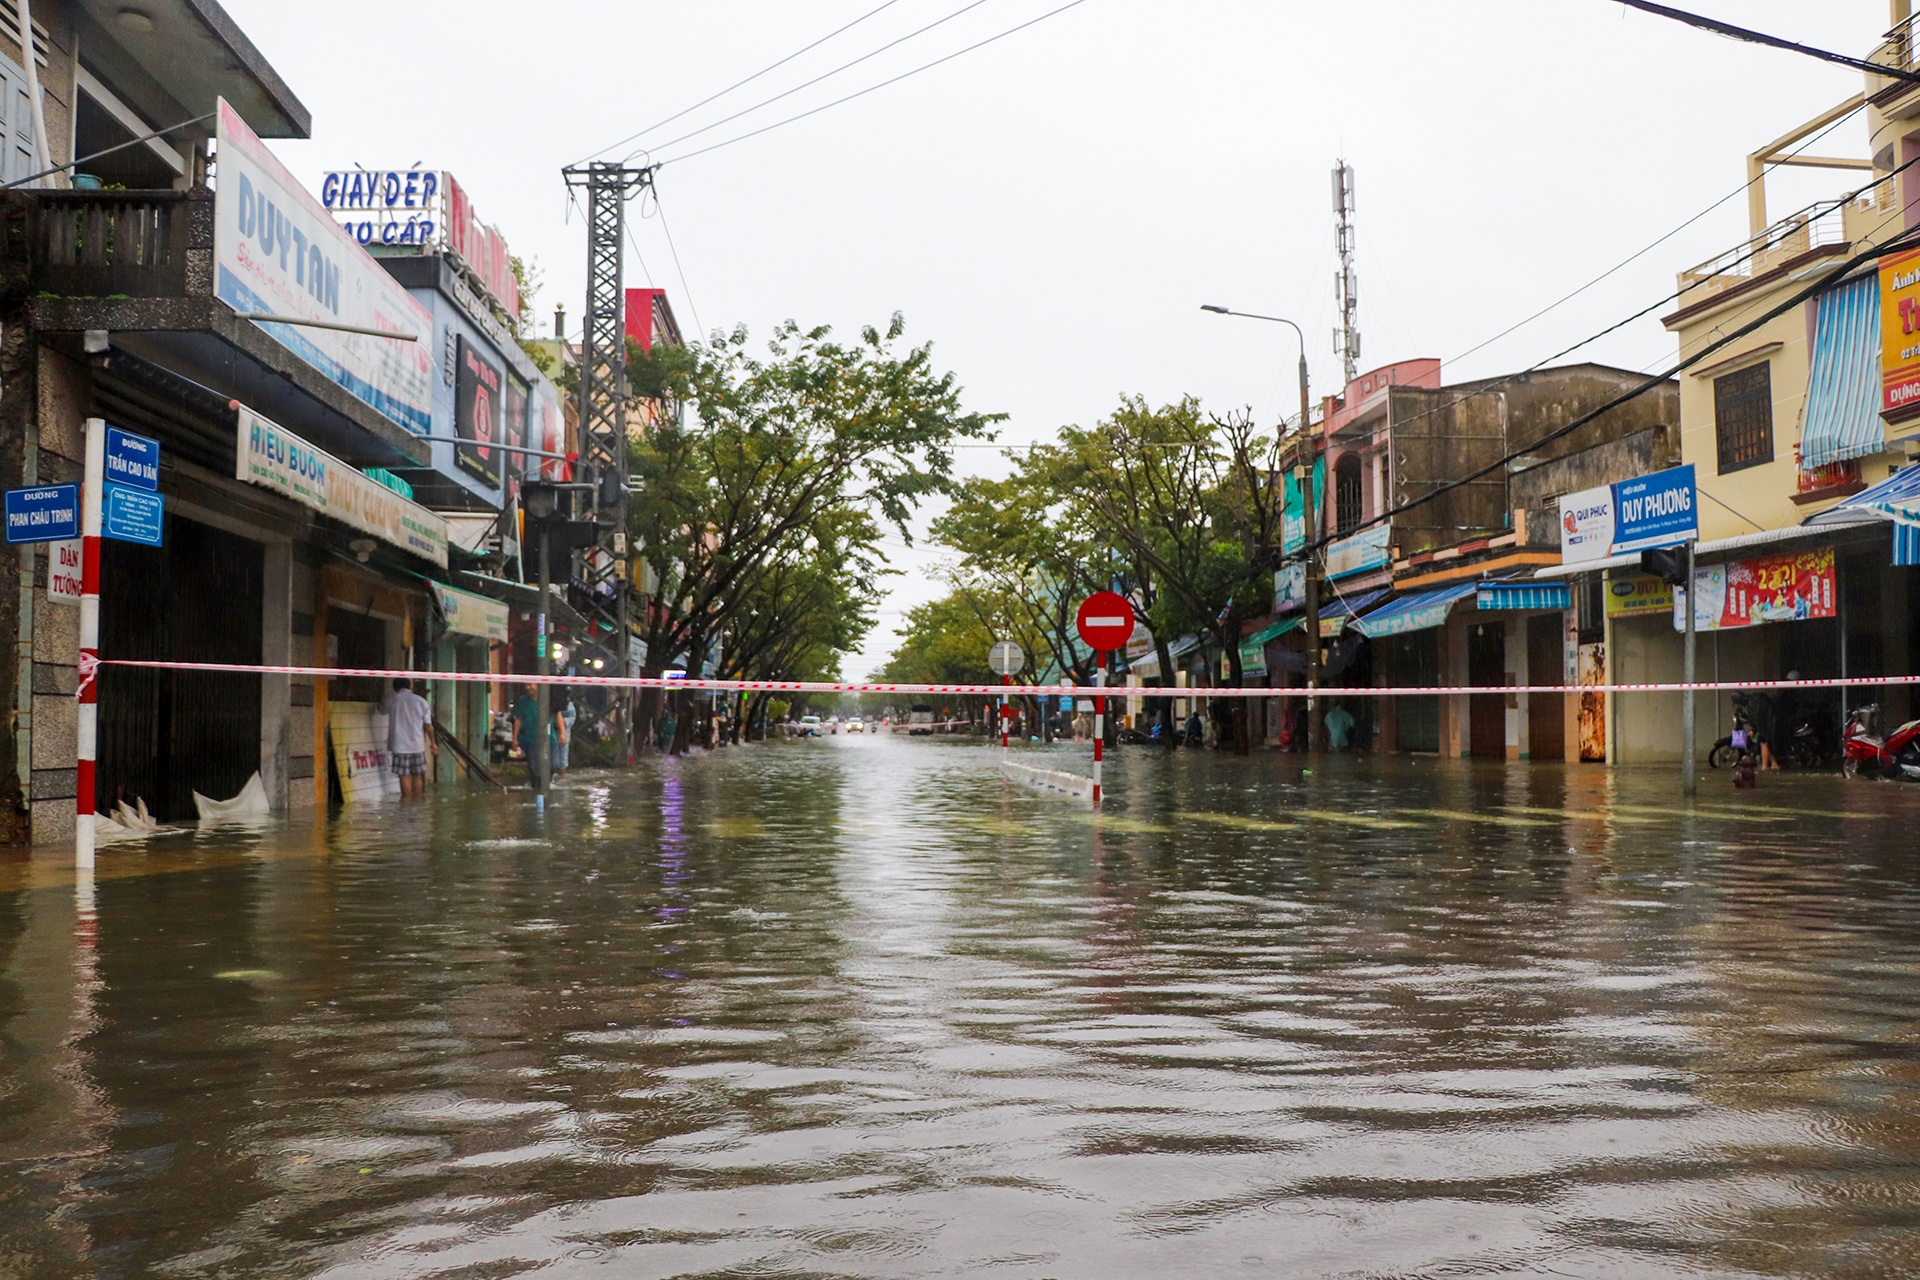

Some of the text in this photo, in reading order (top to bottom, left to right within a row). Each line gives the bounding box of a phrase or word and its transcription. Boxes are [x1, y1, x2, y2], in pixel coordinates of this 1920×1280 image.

[385, 160, 437, 207] DÉP
[382, 212, 435, 245] CẤP
[250, 421, 285, 467] HIỆU
[289, 444, 325, 487] BUÔN
[128, 460, 142, 478] CAO
[143, 462, 157, 481] VÂN
[24, 490, 58, 501] ĐƯỜNG
[9, 508, 73, 527] PHAN CHÂU TRINH
[1622, 497, 1644, 524] DUY
[60, 546, 79, 567] DÁN
